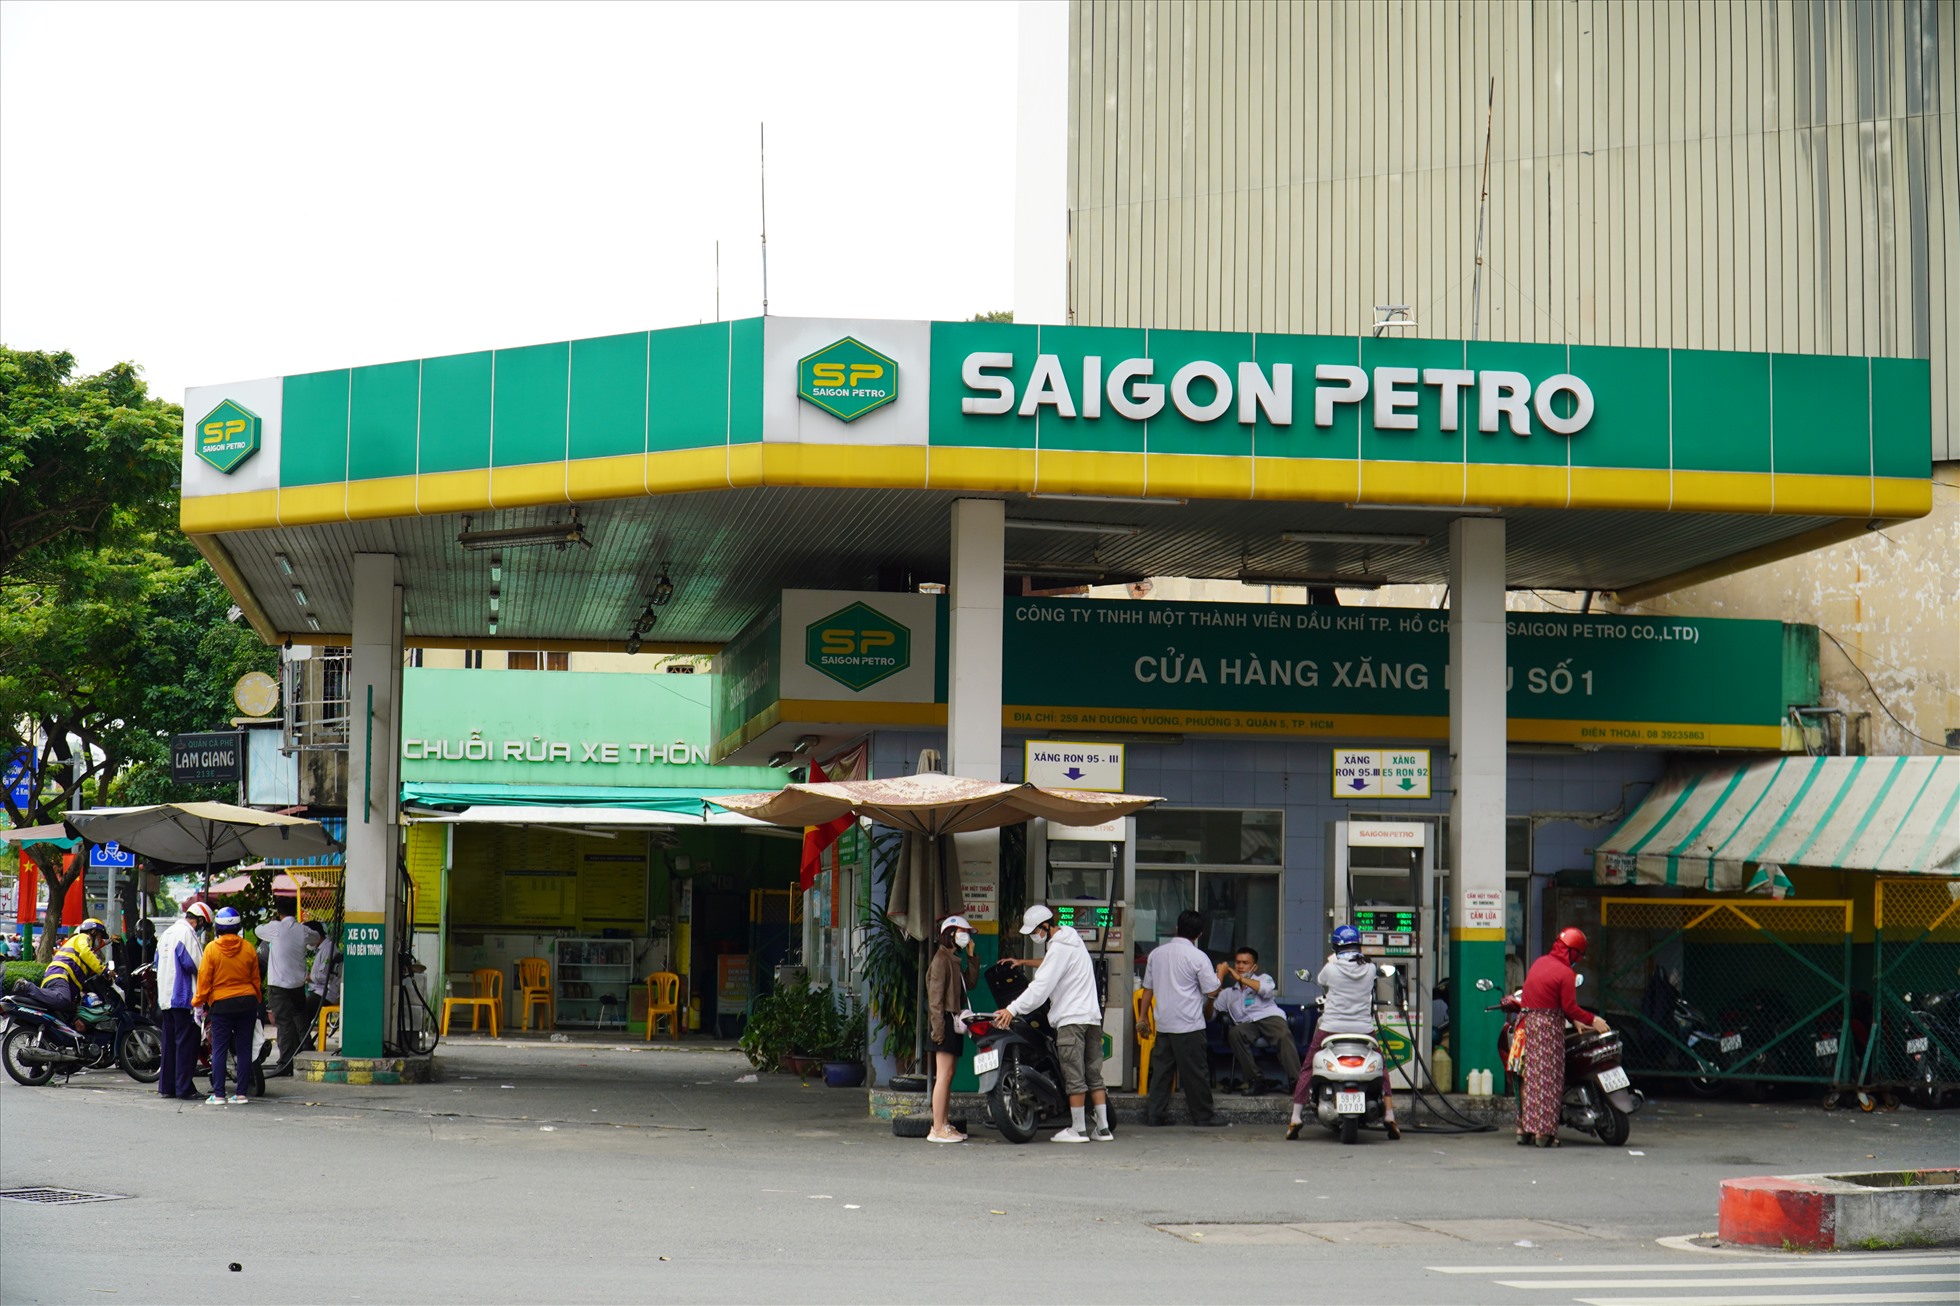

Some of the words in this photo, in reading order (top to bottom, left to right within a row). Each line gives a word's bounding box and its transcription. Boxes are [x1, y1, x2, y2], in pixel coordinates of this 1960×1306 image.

[813, 363, 884, 387] SP
[813, 388, 849, 397] SAIGON
[852, 389, 886, 397] PETRO
[961, 352, 1293, 425] SAIGON
[1315, 364, 1595, 436] PETRO
[203, 419, 246, 444] SP
[202, 444, 226, 453] SAIGON
[226, 441, 246, 451] PETRO
[1016, 604, 1065, 622] CÔNG
[1071, 609, 1091, 622] TY
[1097, 609, 1143, 624] TNHH
[1149, 608, 1185, 628] MỘT
[1190, 609, 1247, 627] THÀNH
[1253, 611, 1291, 628] VIÊN
[1297, 610, 1331, 630] DẦU
[1337, 613, 1364, 631] KHÍ
[1369, 617, 1392, 632] TP.
[1400, 612, 1422, 633] HỒ
[1429, 619, 1450, 633] CH
[1572, 624, 1627, 639] PETRO
[821, 629, 896, 654] SP
[821, 656, 860, 665] SAIGON
[861, 657, 896, 666] PETRO
[1134, 646, 1208, 684] CỬA
[1220, 653, 1319, 687] HÀNG
[1331, 655, 1429, 690] XĂNG
[1528, 658, 1574, 695] SỐ
[1581, 670, 1593, 695] 1
[1014, 712, 1032, 724] ĐỊA
[1060, 714, 1078, 723] 259
[1081, 714, 1096, 724] AN
[1100, 713, 1138, 725] DƯƠNG
[1310, 720, 1334, 730] HCM
[1647, 729, 1658, 739] 08
[403, 728, 494, 761] CHUỖI
[503, 735, 572, 762] RỬA
[580, 742, 620, 763] XE
[175, 751, 199, 769] LAM
[201, 750, 235, 768] GIANG
[1034, 752, 1060, 762] XĂNG
[1063, 754, 1084, 763] RON
[1086, 755, 1099, 763] 95
[1109, 755, 1119, 763] III
[1344, 754, 1370, 764] XĂNG
[1392, 754, 1416, 765] XĂNG
[196, 770, 215, 778] 213E
[1335, 768, 1355, 777] RON
[1382, 768, 1393, 777] E5
[1396, 768, 1414, 777] RON
[1417, 768, 1428, 777] 92
[1470, 910, 1483, 920] CẤM
[347, 928, 359, 940] XE
[367, 943, 384, 956] TRONG
